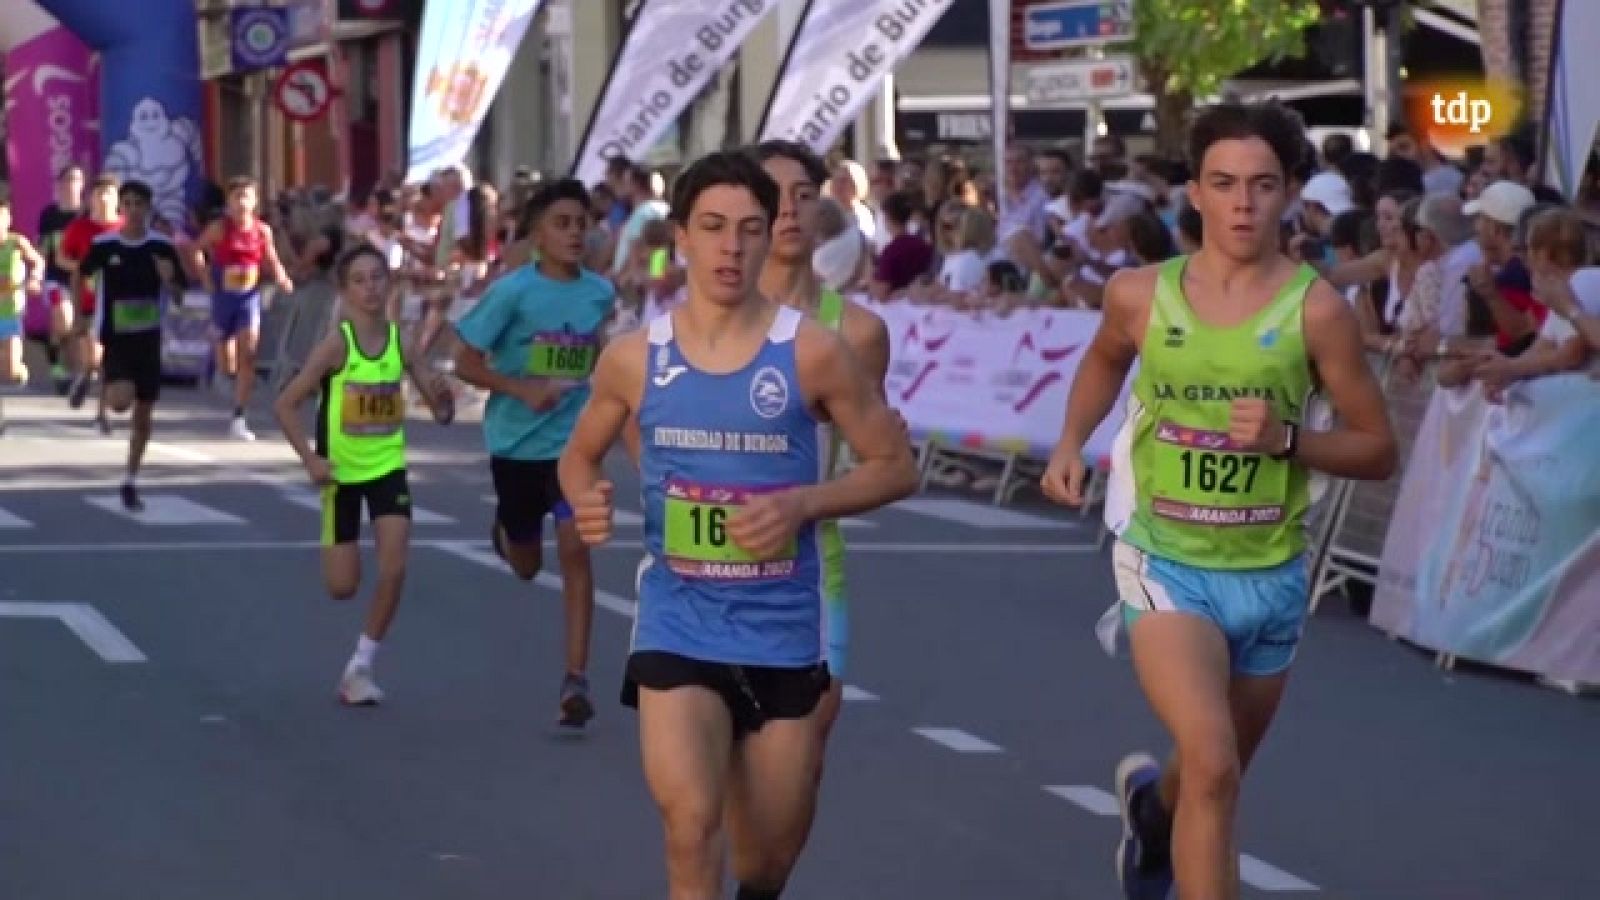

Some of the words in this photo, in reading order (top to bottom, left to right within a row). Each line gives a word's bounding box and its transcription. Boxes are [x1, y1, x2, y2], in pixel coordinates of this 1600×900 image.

[848, 44, 884, 81] de
[598, 91, 672, 160] Diario
[667, 53, 703, 88] de
[1154, 383, 1177, 400] LA
[724, 431, 742, 451] DE
[1181, 449, 1261, 494] 1627
[689, 506, 727, 547] 16
[1188, 505, 1247, 523] ARANDA
[704, 562, 760, 578] ARANDA
